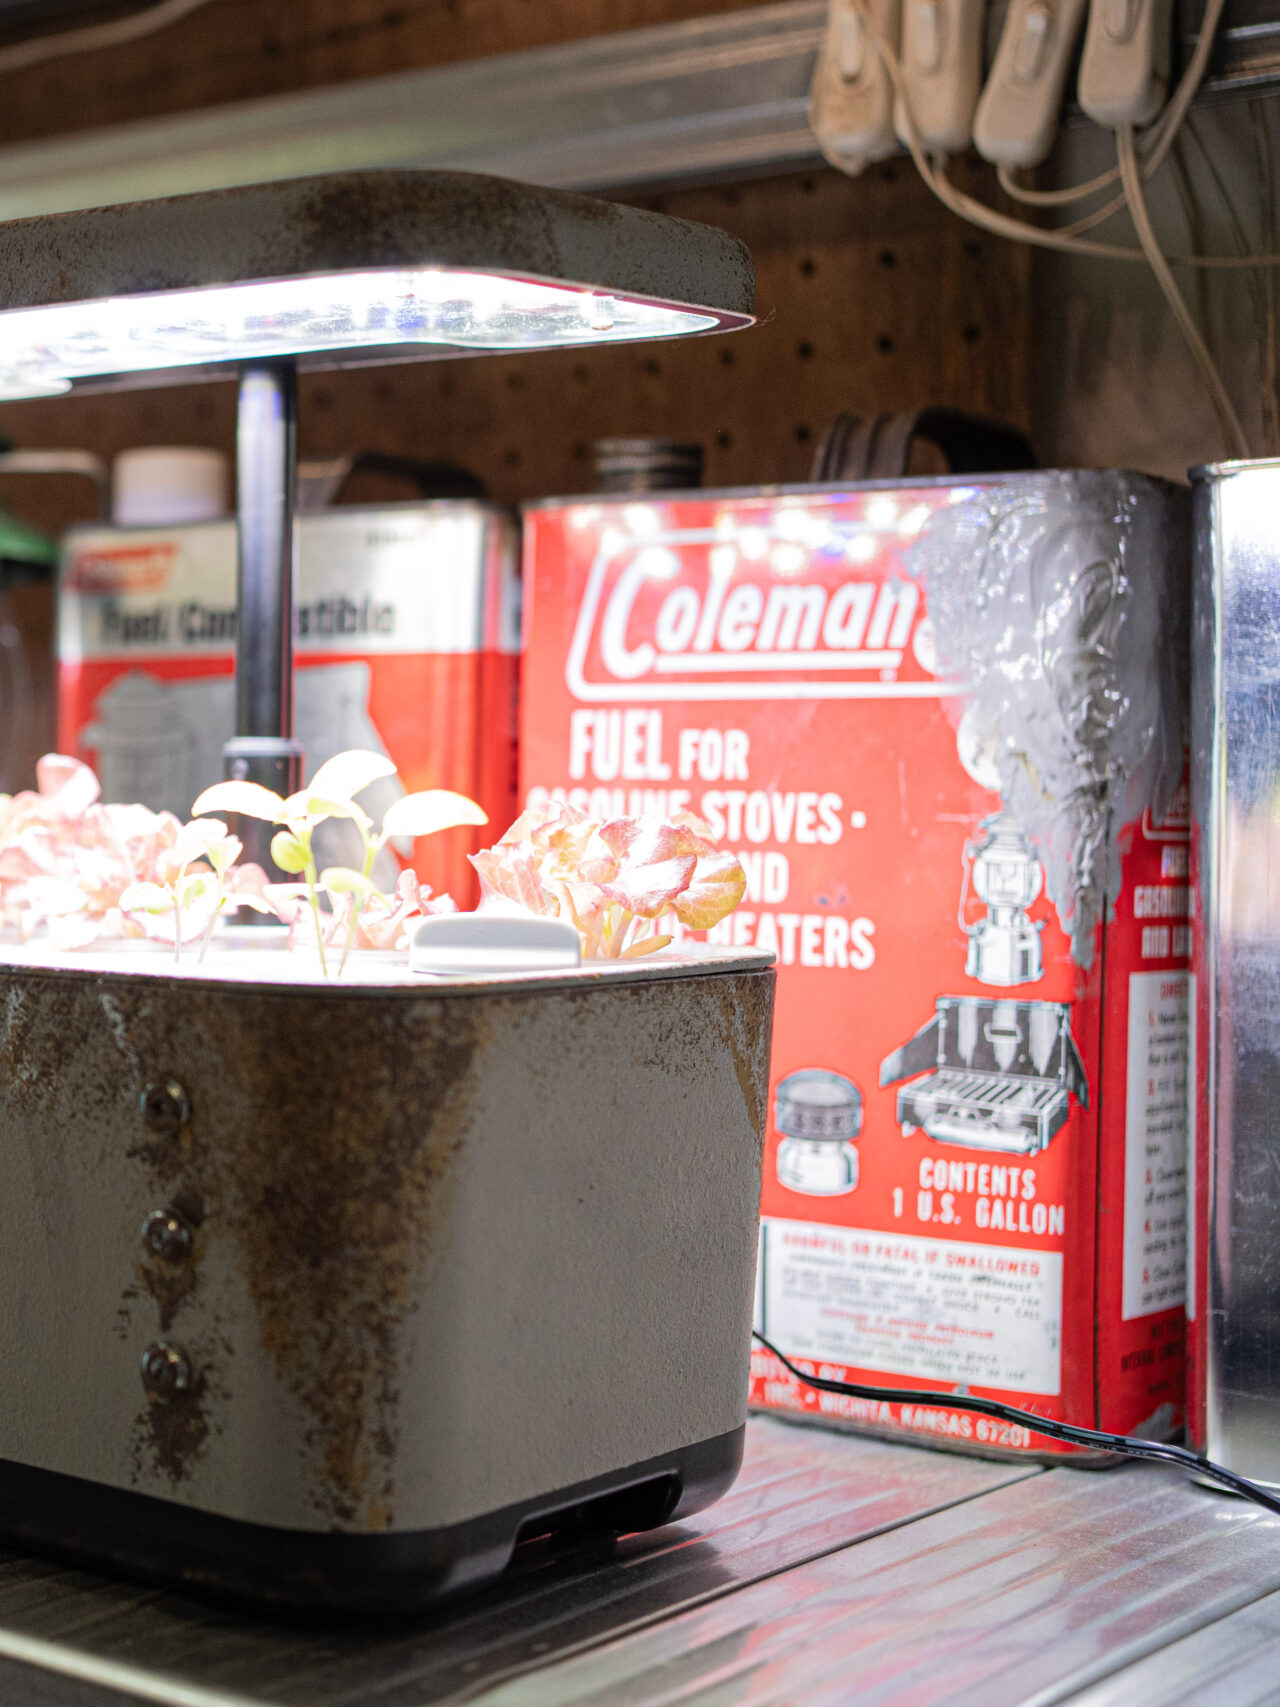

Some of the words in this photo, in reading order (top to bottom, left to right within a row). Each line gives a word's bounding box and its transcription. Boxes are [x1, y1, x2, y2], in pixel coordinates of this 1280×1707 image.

[178, 592, 397, 645] Comstible
[600, 546, 919, 679] Coleman
[569, 708, 672, 782] FUEL
[679, 728, 751, 782] FOR
[701, 789, 844, 845] STOVES
[919, 1157, 1036, 1200] CONTENTS
[892, 1186, 904, 1218] 1
[917, 1189, 962, 1225] U.S.
[975, 1196, 1065, 1236] GALLON
[945, 1250, 1041, 1278] SWALLOWED
[900, 1404, 972, 1438] KANSAS
[975, 1417, 1031, 1449] 67201
